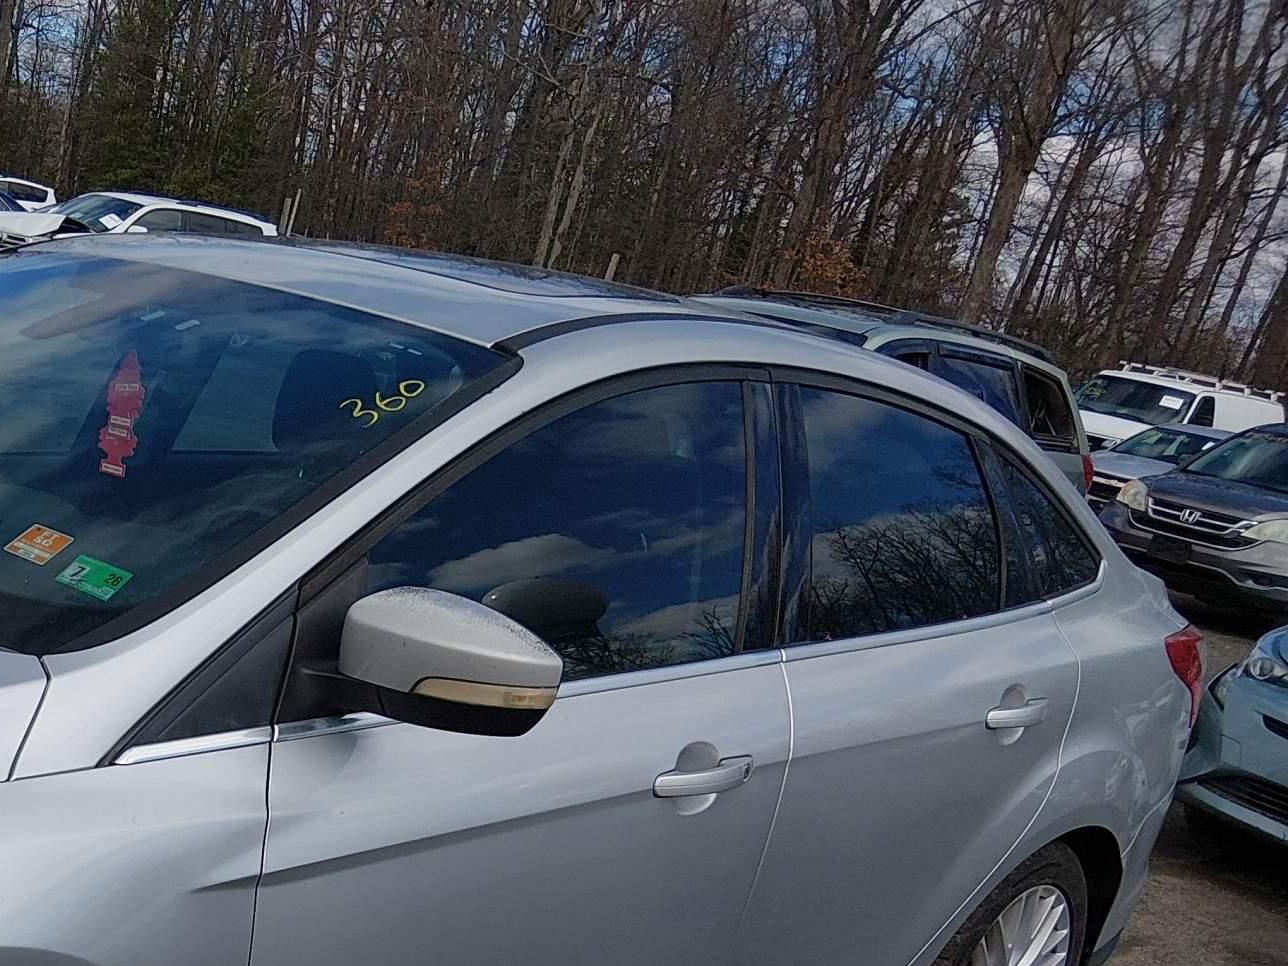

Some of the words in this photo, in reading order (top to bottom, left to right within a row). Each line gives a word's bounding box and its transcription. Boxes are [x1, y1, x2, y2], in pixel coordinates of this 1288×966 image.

[338, 379, 426, 429] 360
[69, 565, 87, 578] 7
[103, 573, 124, 587] 26
